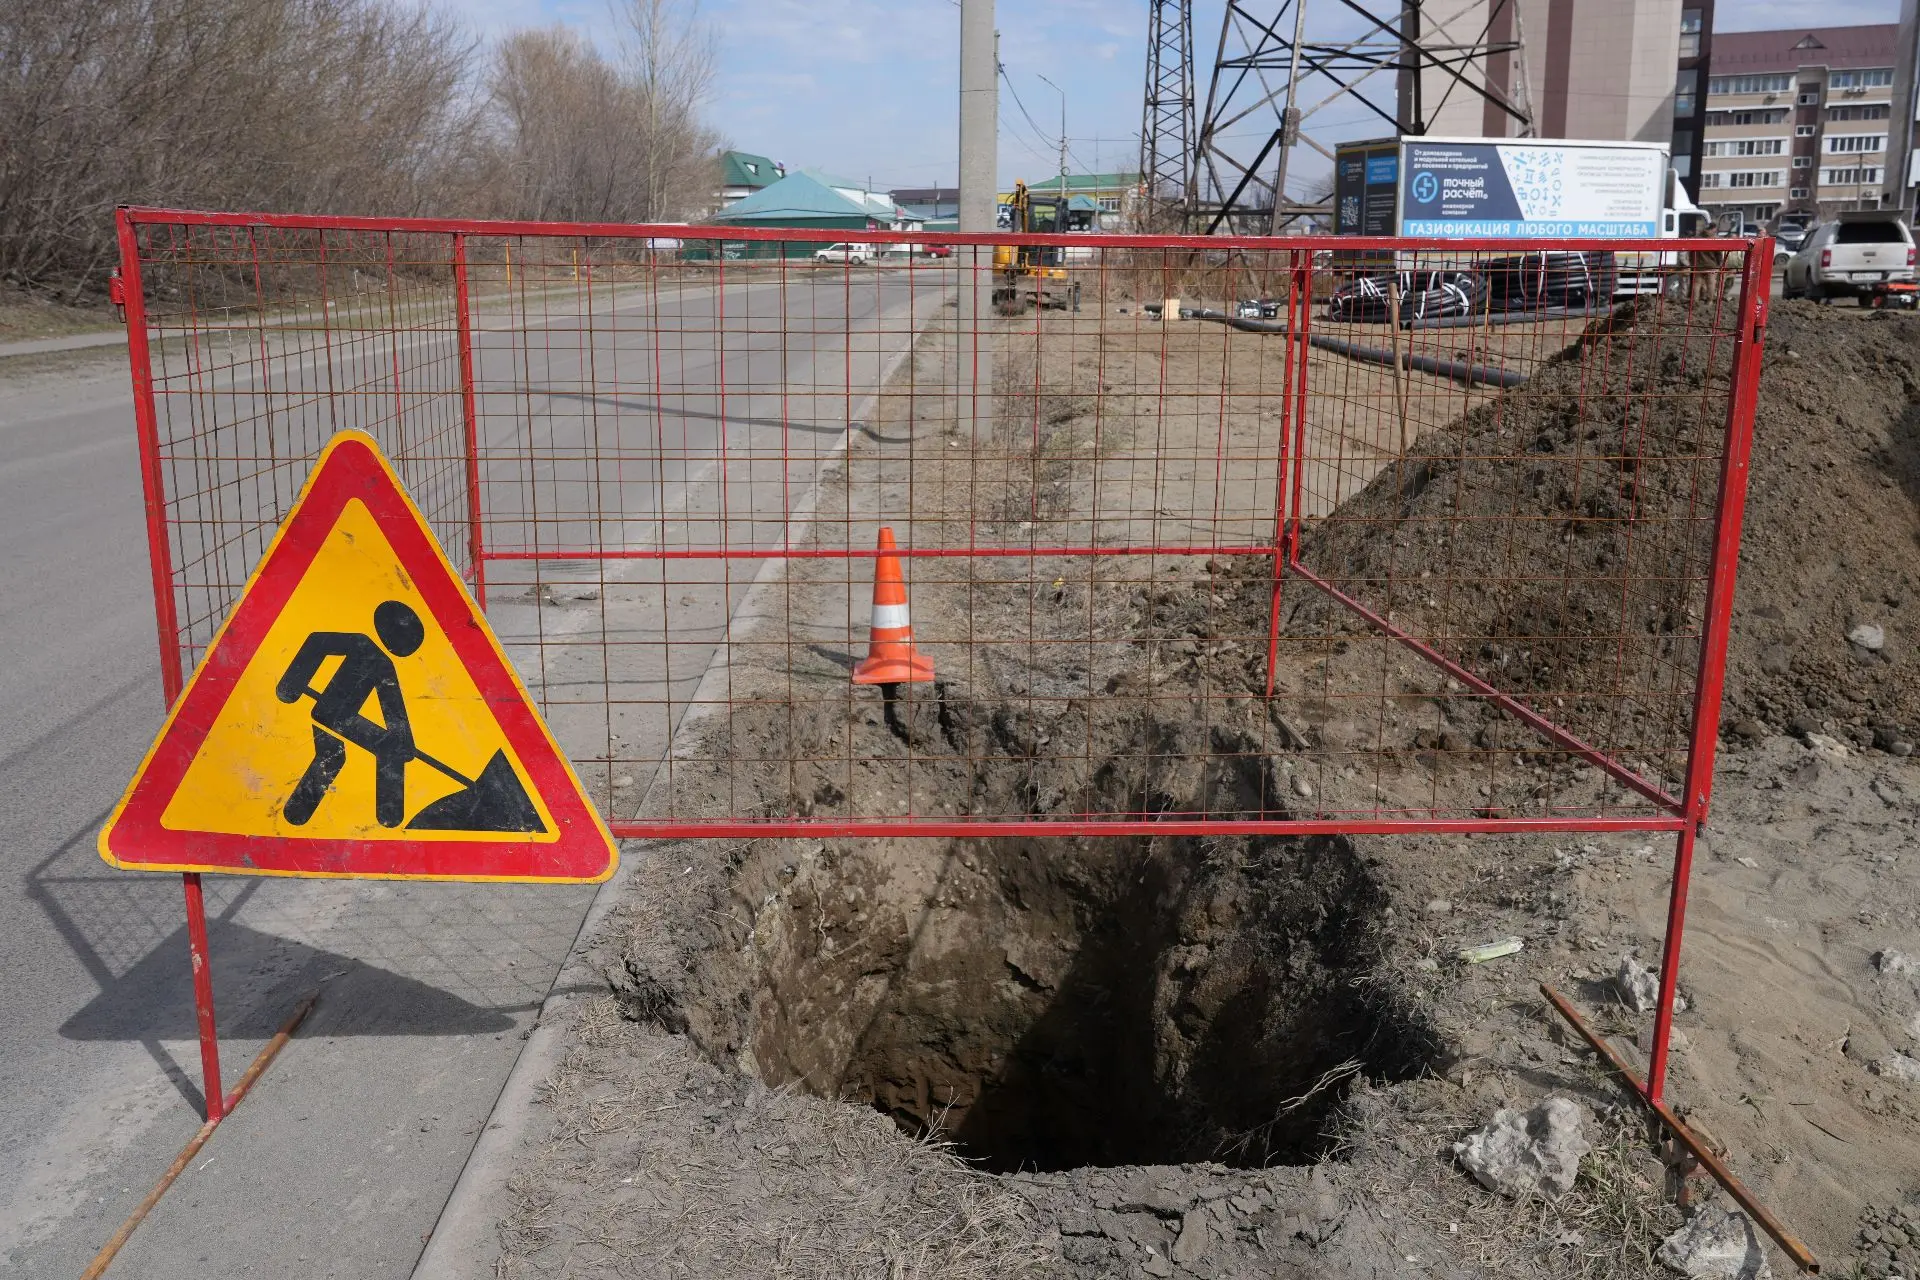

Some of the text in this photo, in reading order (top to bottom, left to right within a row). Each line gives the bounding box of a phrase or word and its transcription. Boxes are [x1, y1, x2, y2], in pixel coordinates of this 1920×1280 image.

[1443, 177, 1484, 187] точный
[1410, 222, 1648, 235] ГАЗИФИКАЦИЯ ЛЮБОГО МАСШТАБА
